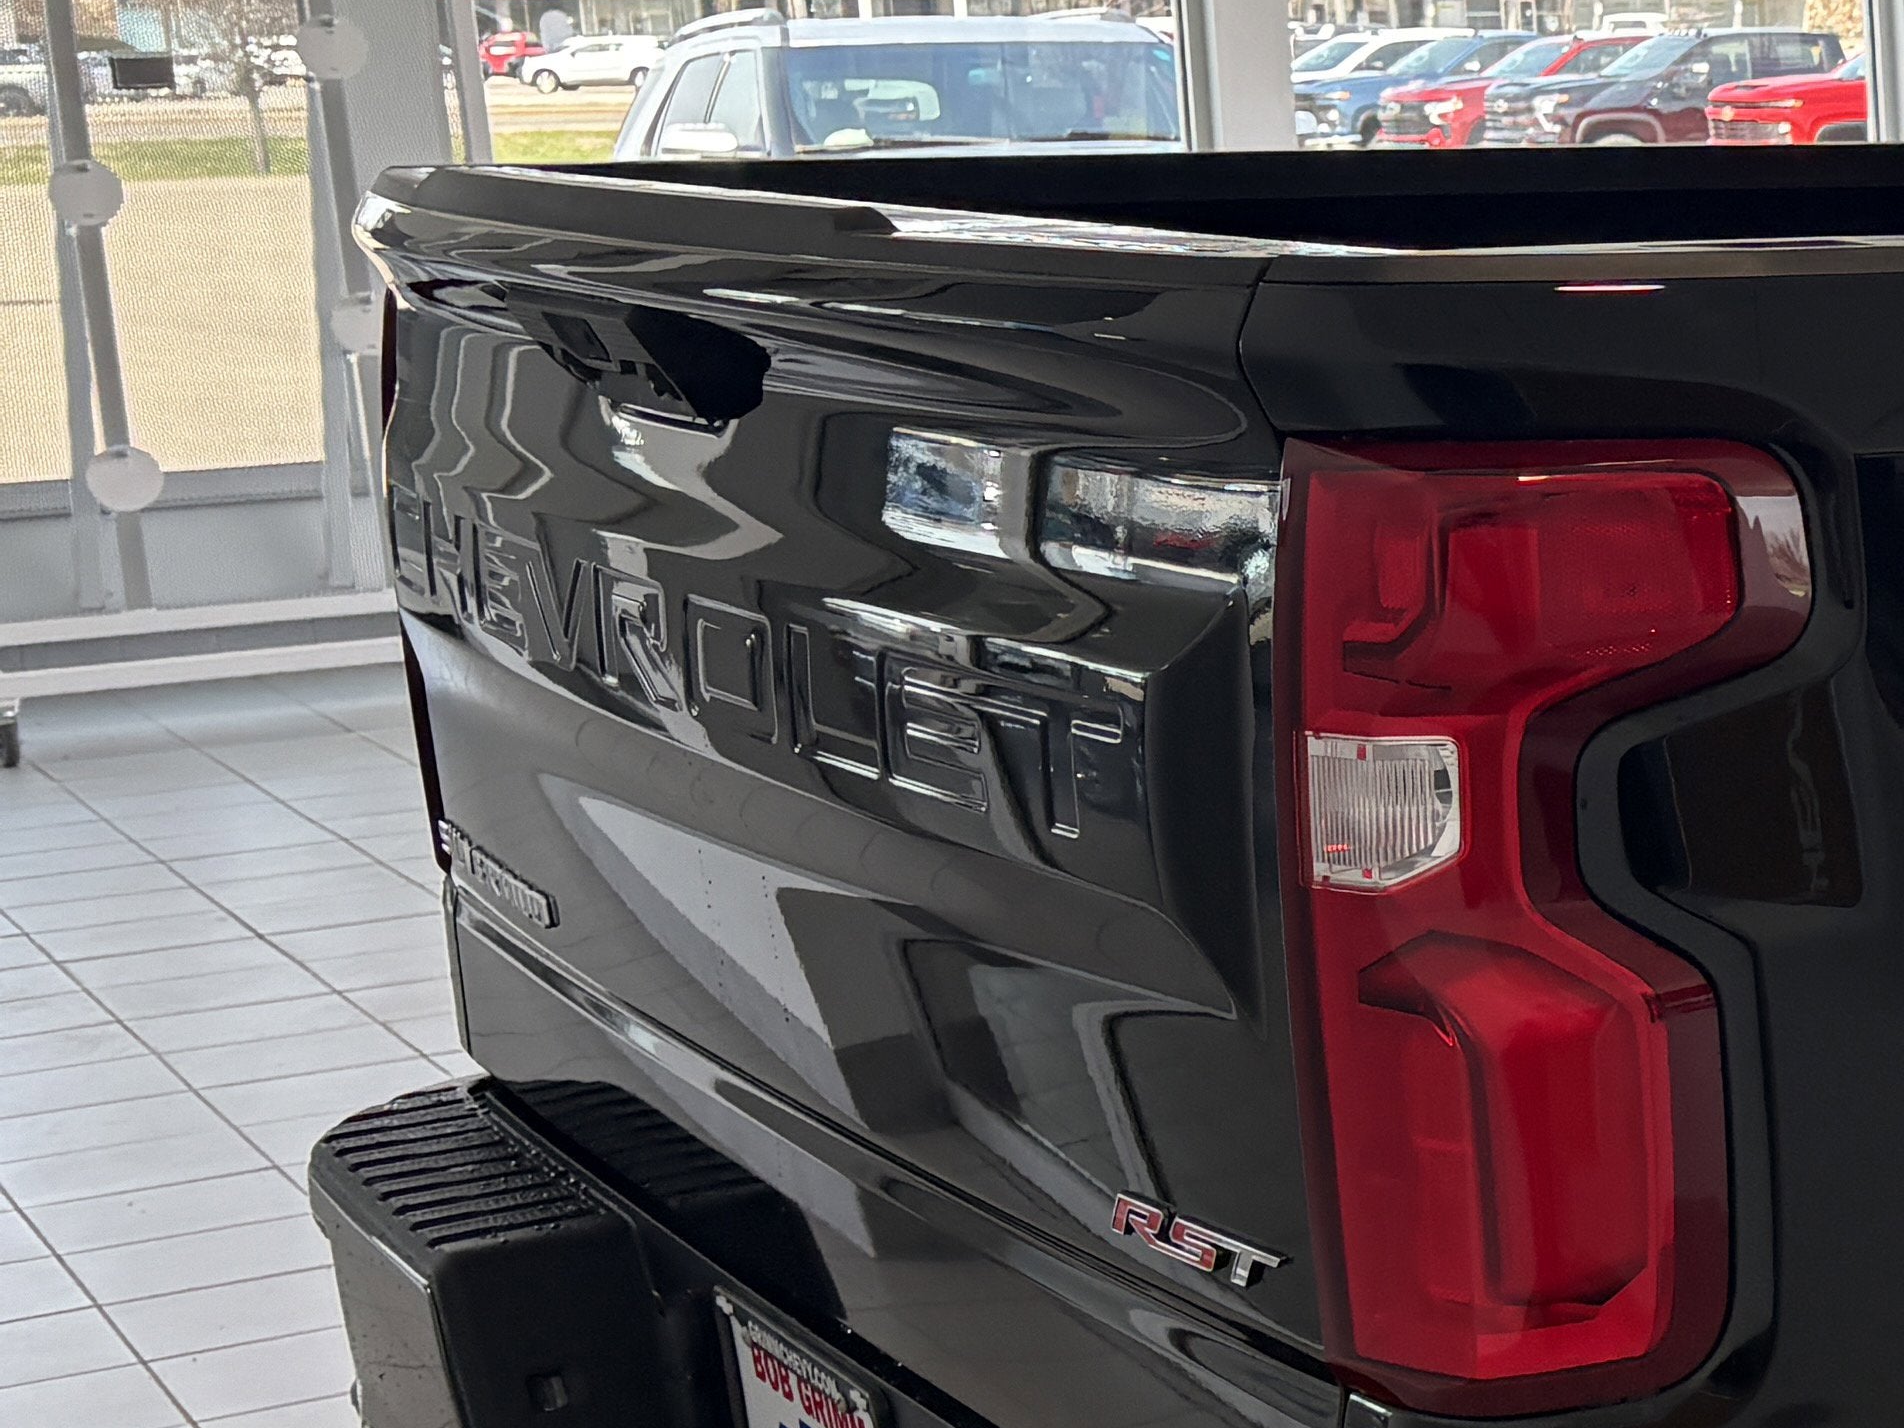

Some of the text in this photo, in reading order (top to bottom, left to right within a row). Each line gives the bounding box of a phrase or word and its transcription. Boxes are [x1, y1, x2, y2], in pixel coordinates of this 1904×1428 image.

[390, 482, 1126, 841] CHEVROLET
[1111, 1190, 1289, 1287] RST
[751, 1341, 795, 1403] BOB
